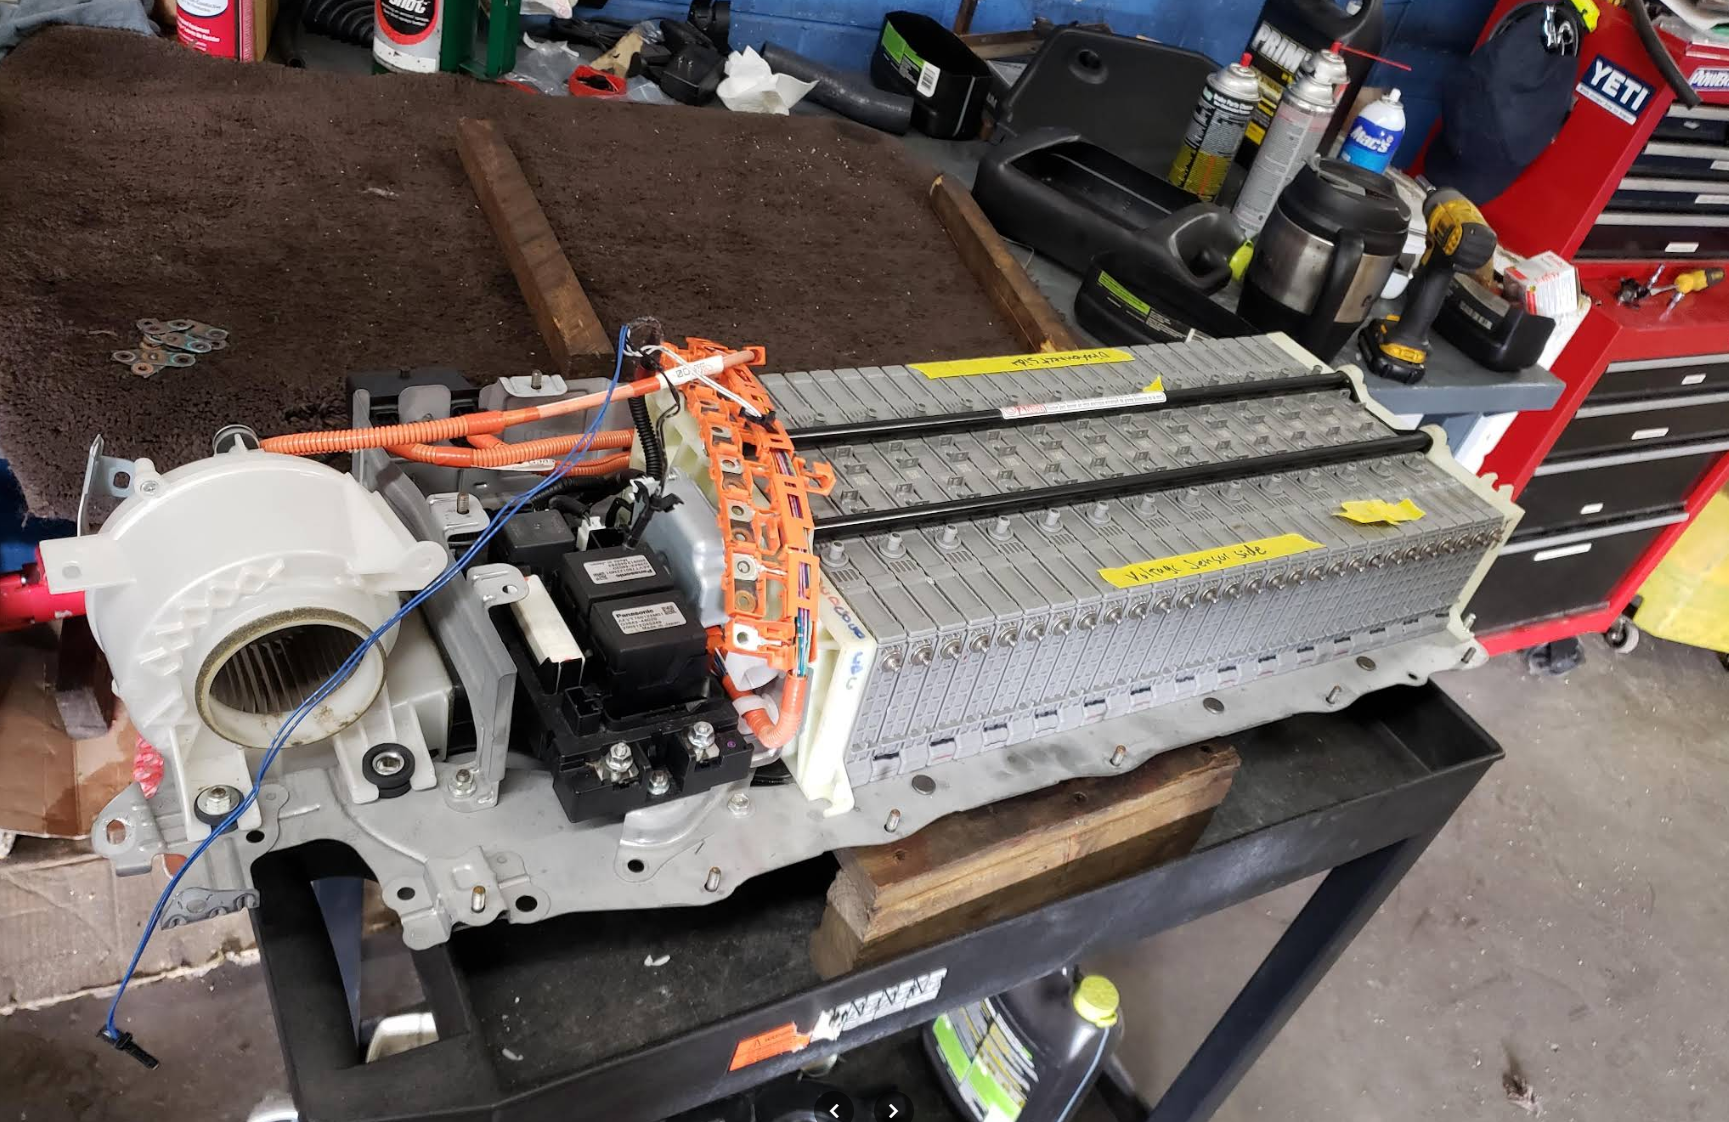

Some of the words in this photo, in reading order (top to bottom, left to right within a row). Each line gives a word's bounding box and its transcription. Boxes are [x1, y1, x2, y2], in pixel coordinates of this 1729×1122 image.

[1591, 60, 1649, 111] YETI
[1350, 125, 1391, 153] Mac's
[616, 569, 653, 578] Panasonic
[1125, 562, 1182, 582] Voltage
[615, 609, 654, 618] Panasonic
